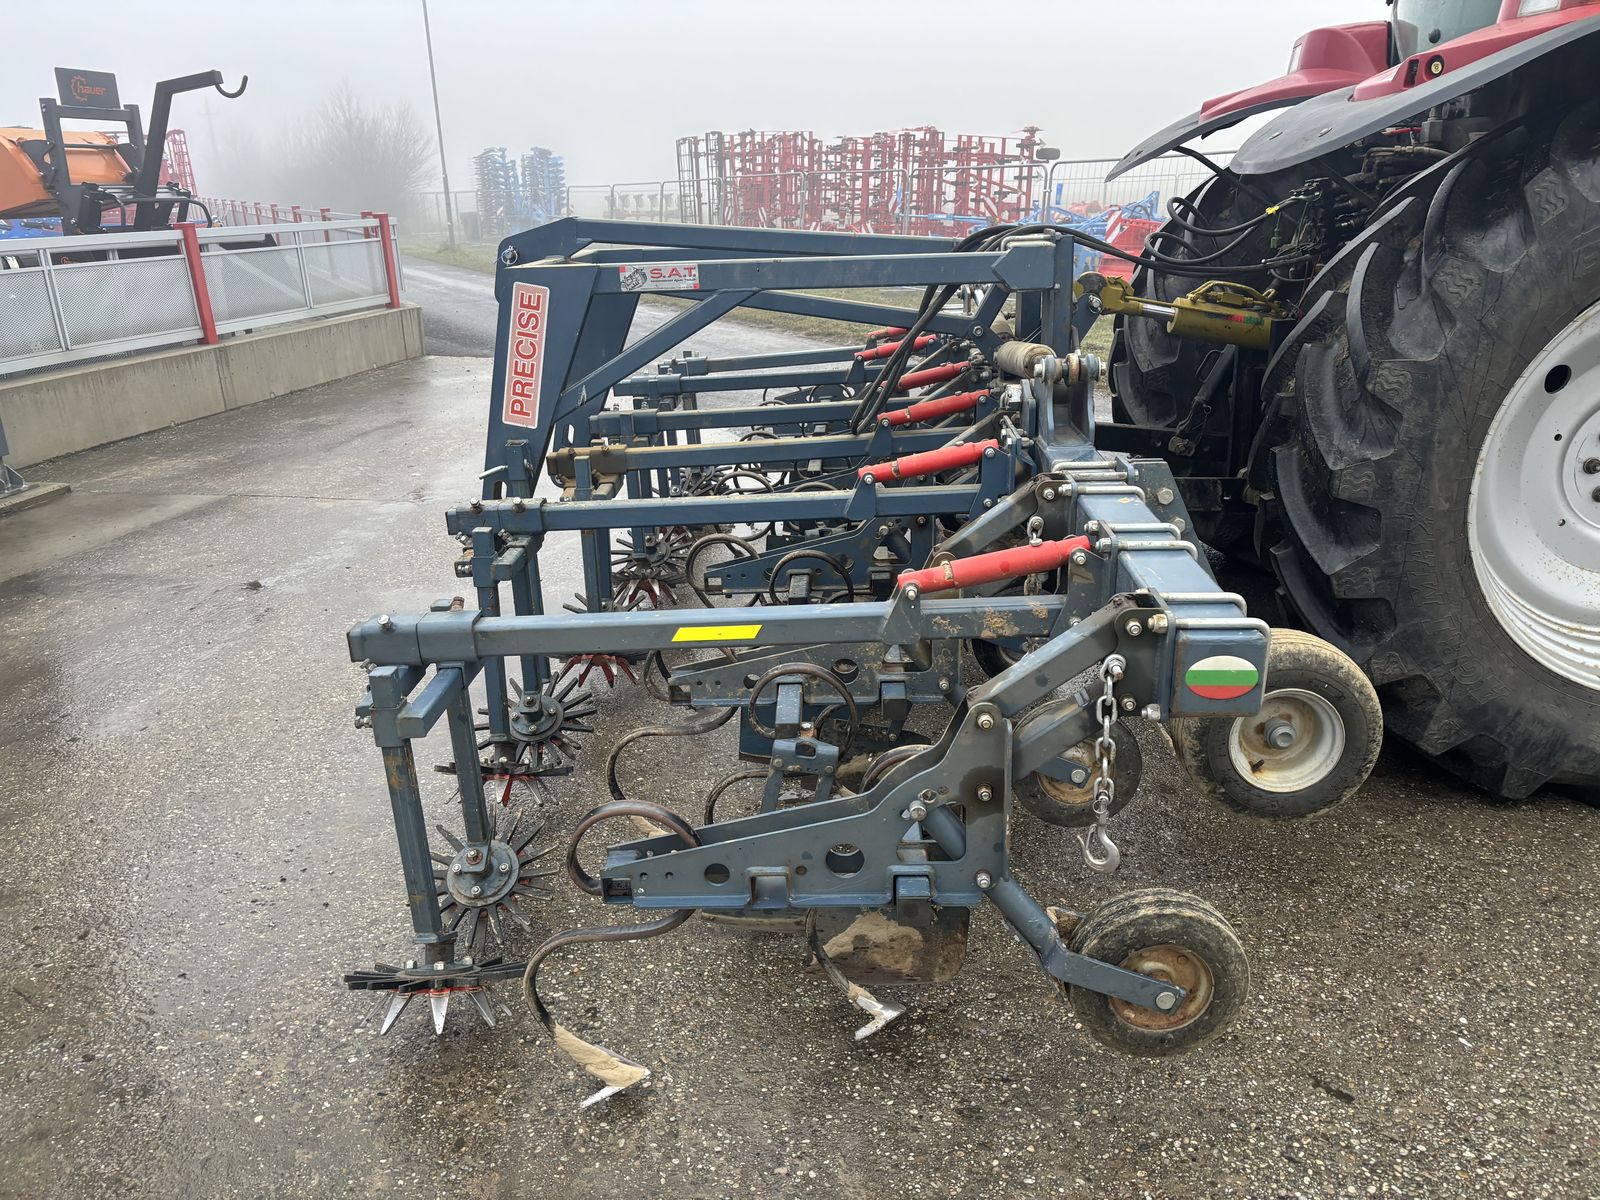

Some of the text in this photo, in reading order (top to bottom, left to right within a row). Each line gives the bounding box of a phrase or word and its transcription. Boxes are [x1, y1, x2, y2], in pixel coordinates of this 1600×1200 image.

[77, 80, 106, 96] hauer
[649, 266, 697, 279] S.A.T.
[510, 291, 542, 418] PRECISE
